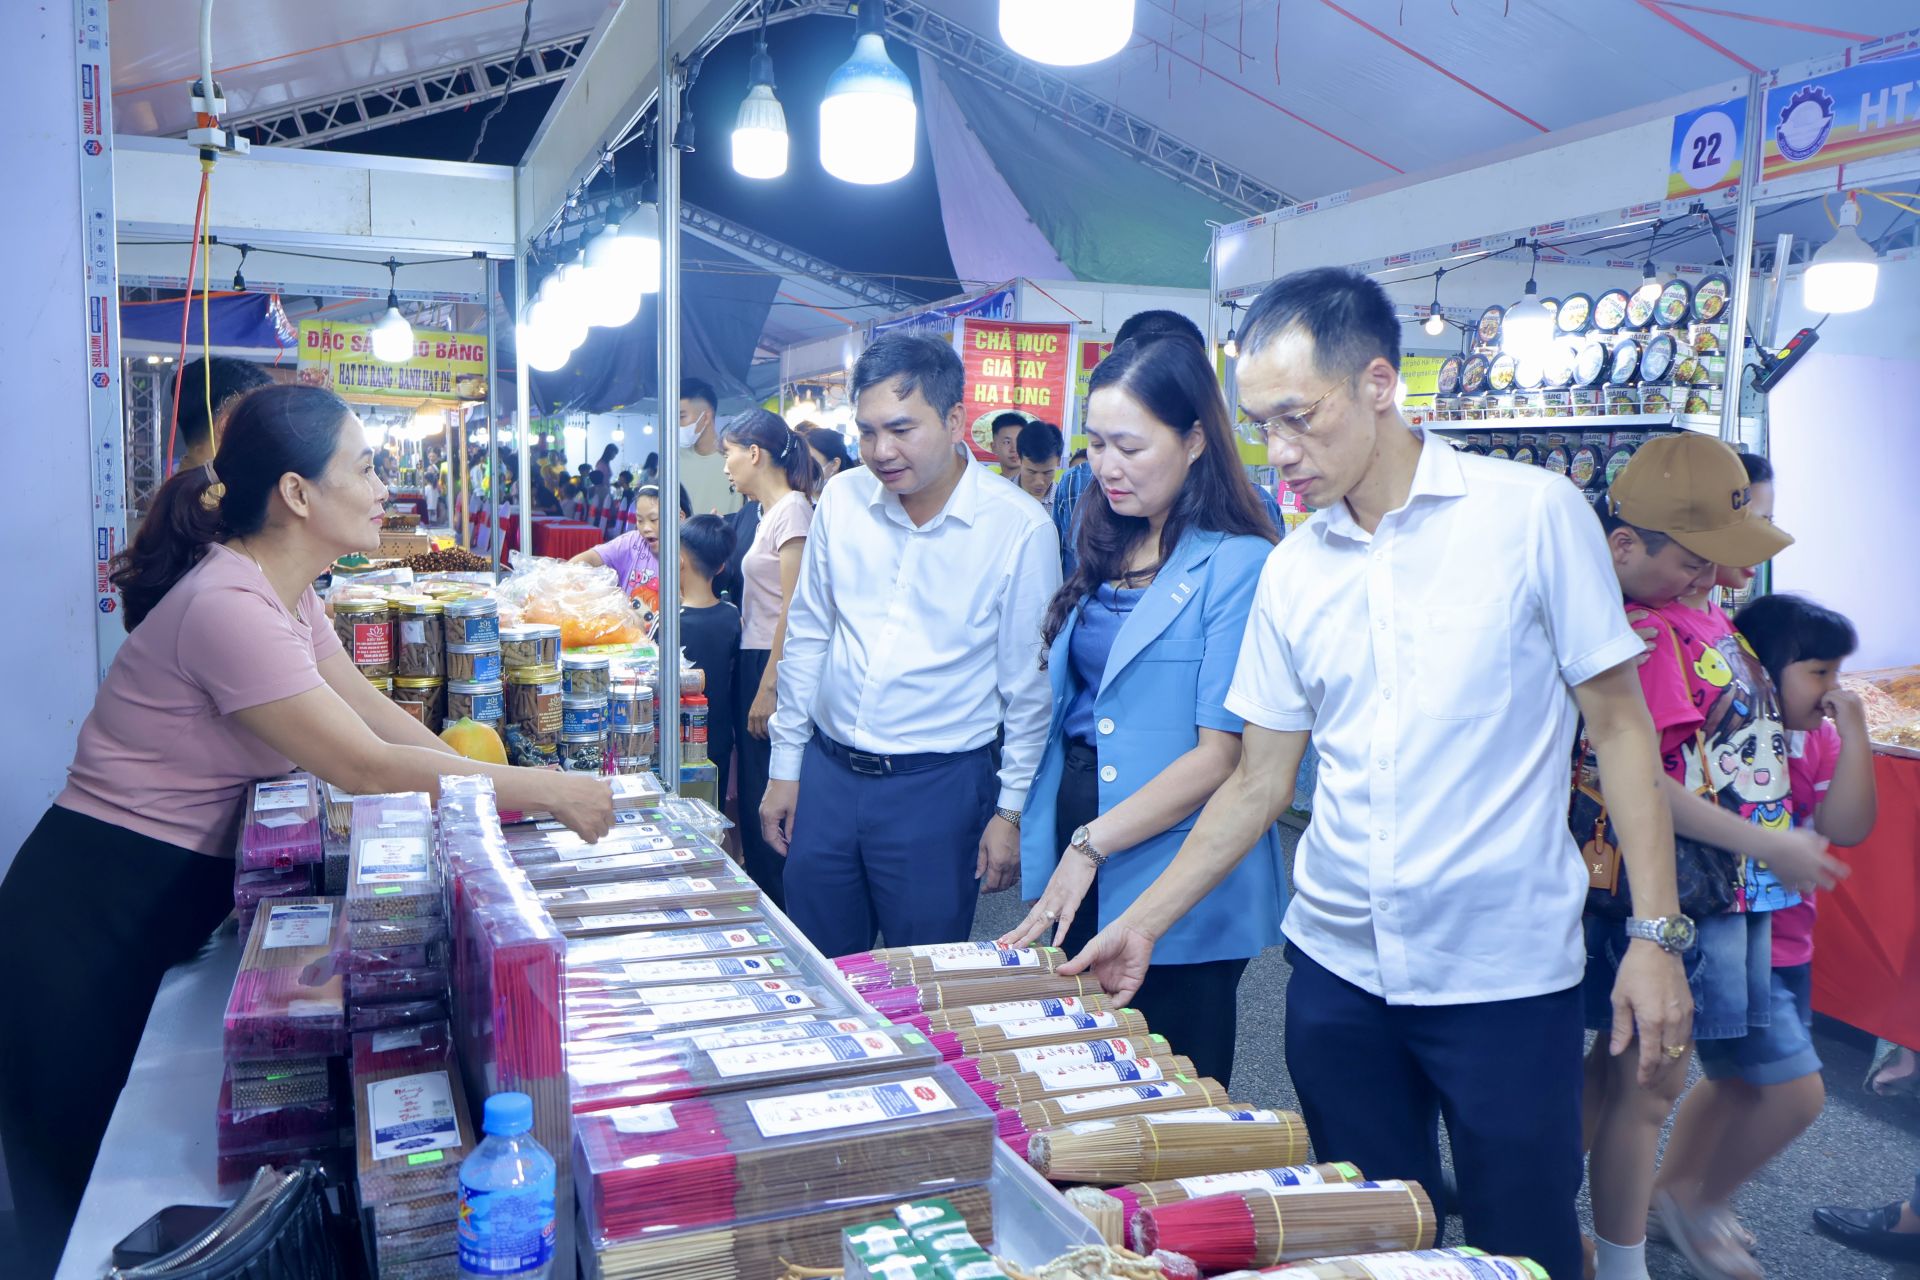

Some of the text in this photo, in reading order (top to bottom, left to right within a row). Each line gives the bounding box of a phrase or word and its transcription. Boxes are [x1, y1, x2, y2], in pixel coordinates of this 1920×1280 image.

[83, 101, 94, 136] SHALUMI
[1859, 81, 1920, 132] HT
[1692, 132, 1722, 170] 22
[1004, 303, 1012, 319] 27
[91, 335, 102, 368] SHALUMI
[307, 328, 344, 352] ĐẶC
[435, 336, 484, 362] BẰNG
[975, 327, 1057, 357] CHẢ MỰC
[339, 363, 356, 391] HẠT
[370, 365, 393, 389] RANG
[982, 356, 1047, 380] GIÃ TAY
[974, 384, 1051, 408] HẠ LONG
[97, 562, 109, 593] SHALUMI
